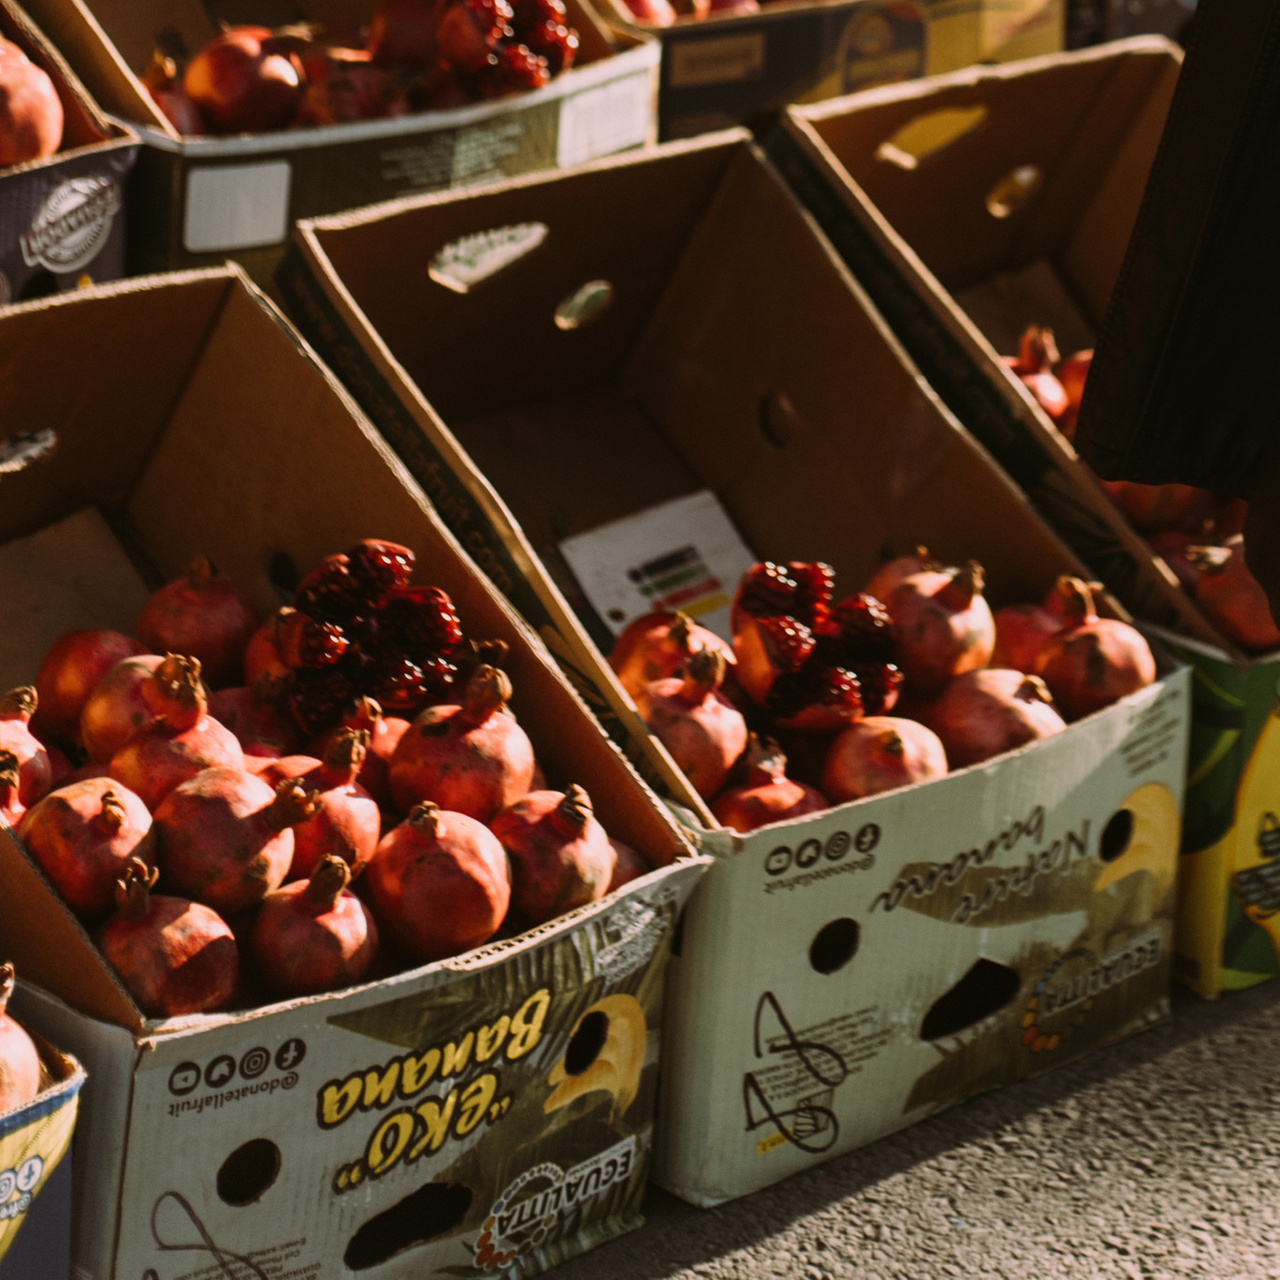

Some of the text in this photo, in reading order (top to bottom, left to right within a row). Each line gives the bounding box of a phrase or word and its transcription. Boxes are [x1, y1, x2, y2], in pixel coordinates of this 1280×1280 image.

[167, 1071, 300, 1117] @donatellafruit
[320, 987, 552, 1126] Banana
[498, 1149, 632, 1237] ECUALITTA
